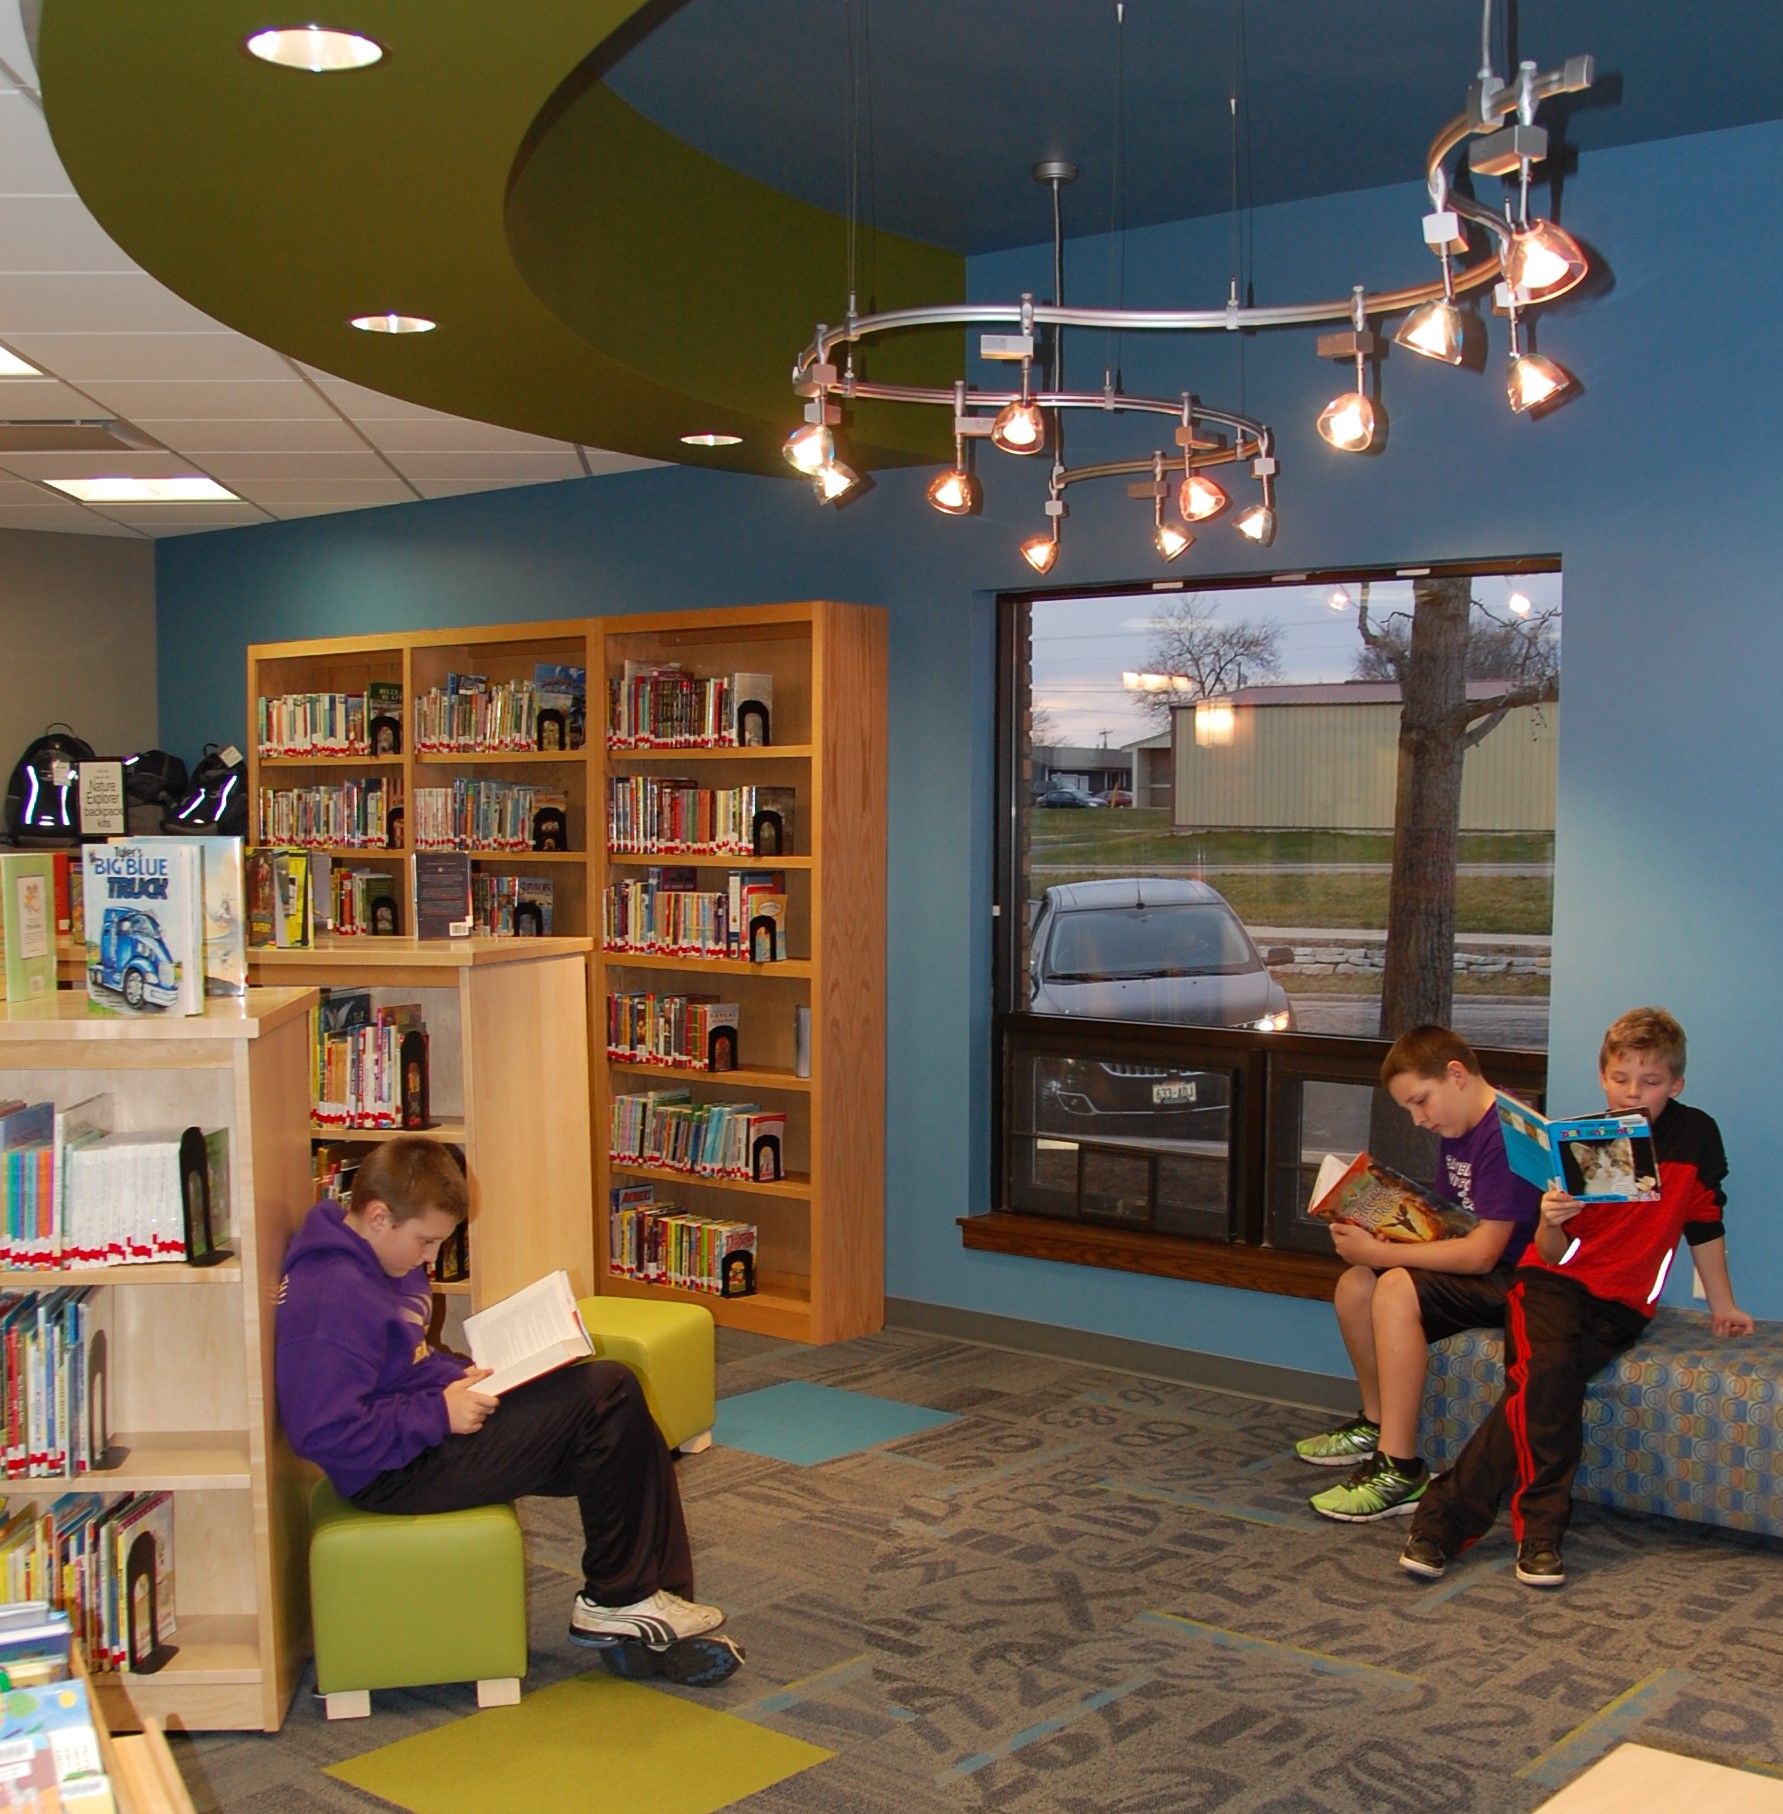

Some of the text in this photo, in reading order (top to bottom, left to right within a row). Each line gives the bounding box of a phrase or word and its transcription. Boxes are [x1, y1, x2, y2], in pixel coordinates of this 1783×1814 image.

[89, 780, 116, 792] Nature
[86, 791, 120, 807] Explorer
[84, 805, 124, 819] backpack
[97, 819, 112, 829] kits
[95, 856, 168, 876] BIG BLUE
[107, 877, 169, 900] TRUCK
[1561, 1126, 1635, 1141] pet animals
[1351, 1183, 1390, 1223] GREEK
